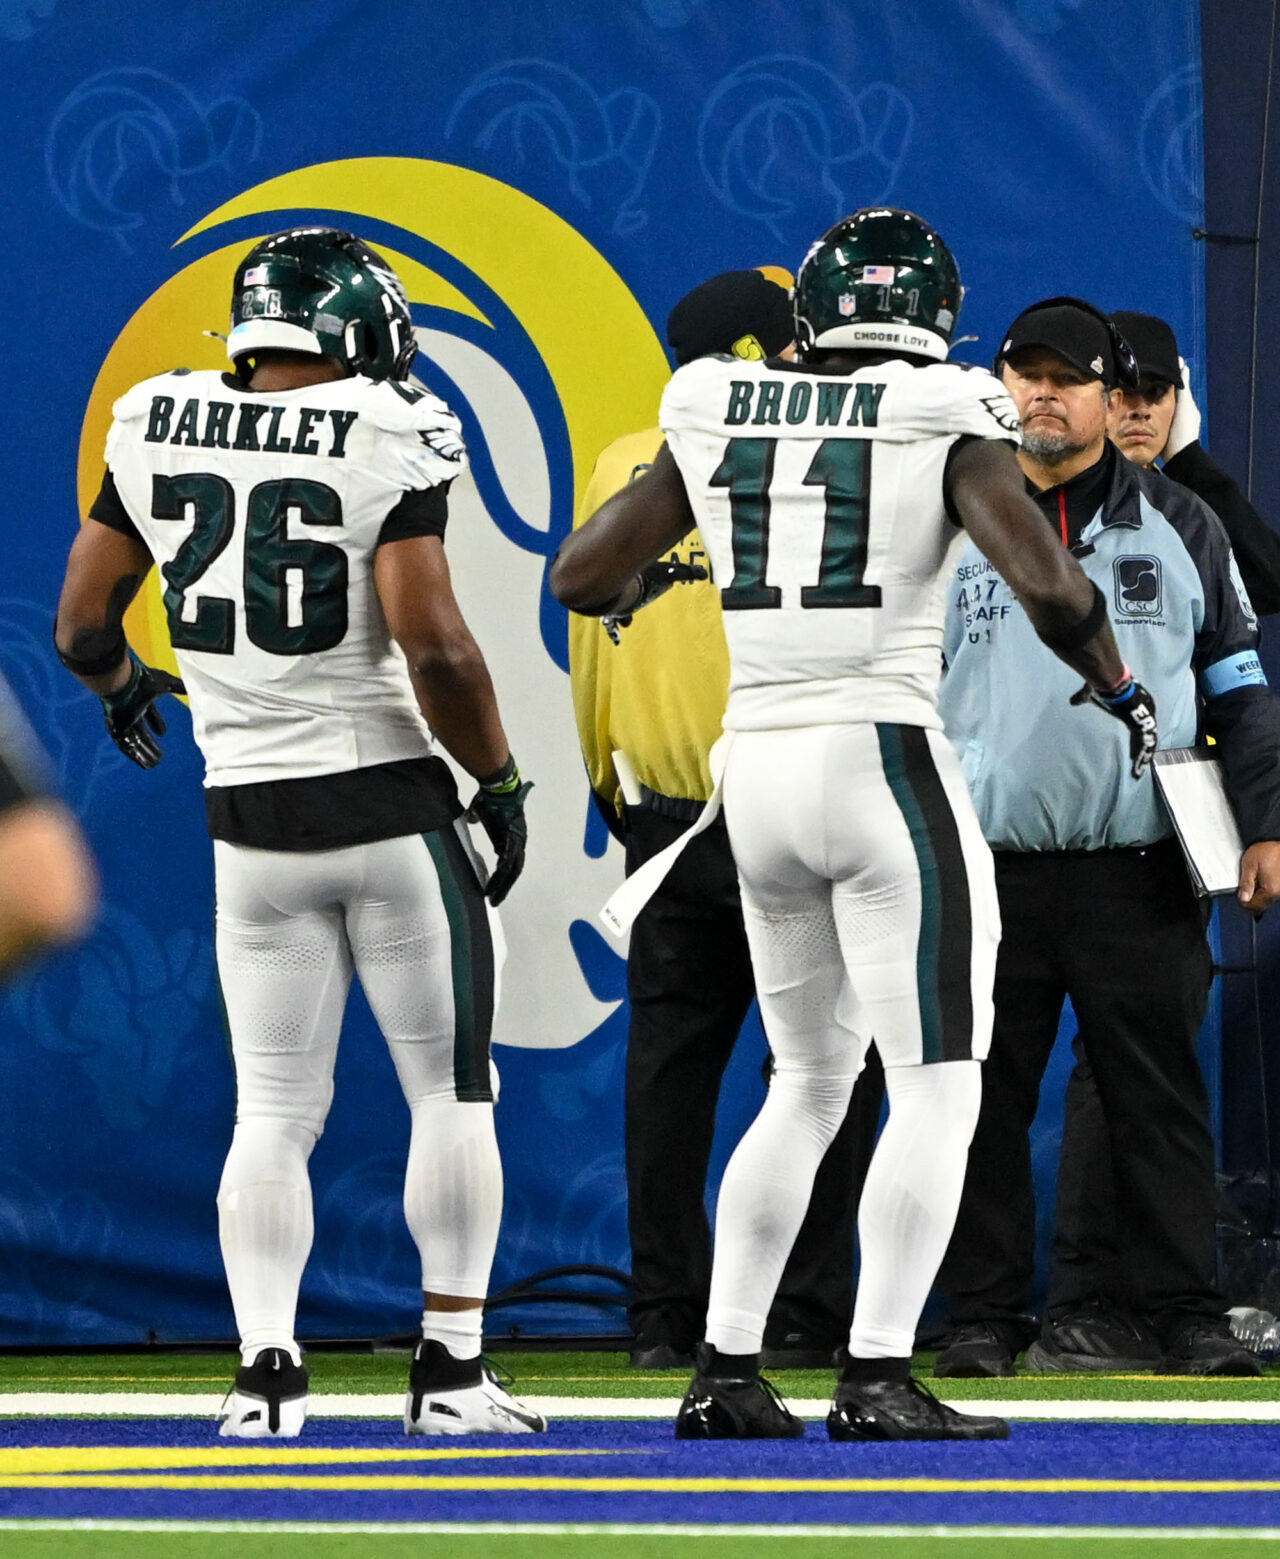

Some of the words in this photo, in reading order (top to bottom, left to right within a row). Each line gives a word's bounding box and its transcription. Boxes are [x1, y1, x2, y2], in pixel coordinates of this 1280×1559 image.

[241, 288, 283, 319] 26
[853, 331, 900, 343] CHOOSE
[903, 333, 929, 348] LOVE
[724, 380, 887, 428] BROWN
[144, 395, 359, 458] BARKLEY
[708, 437, 883, 611] 11
[151, 472, 349, 656] 26
[957, 561, 995, 581] SECUR
[1125, 600, 1154, 613] CSC
[1114, 618, 1167, 628] Supervisor
